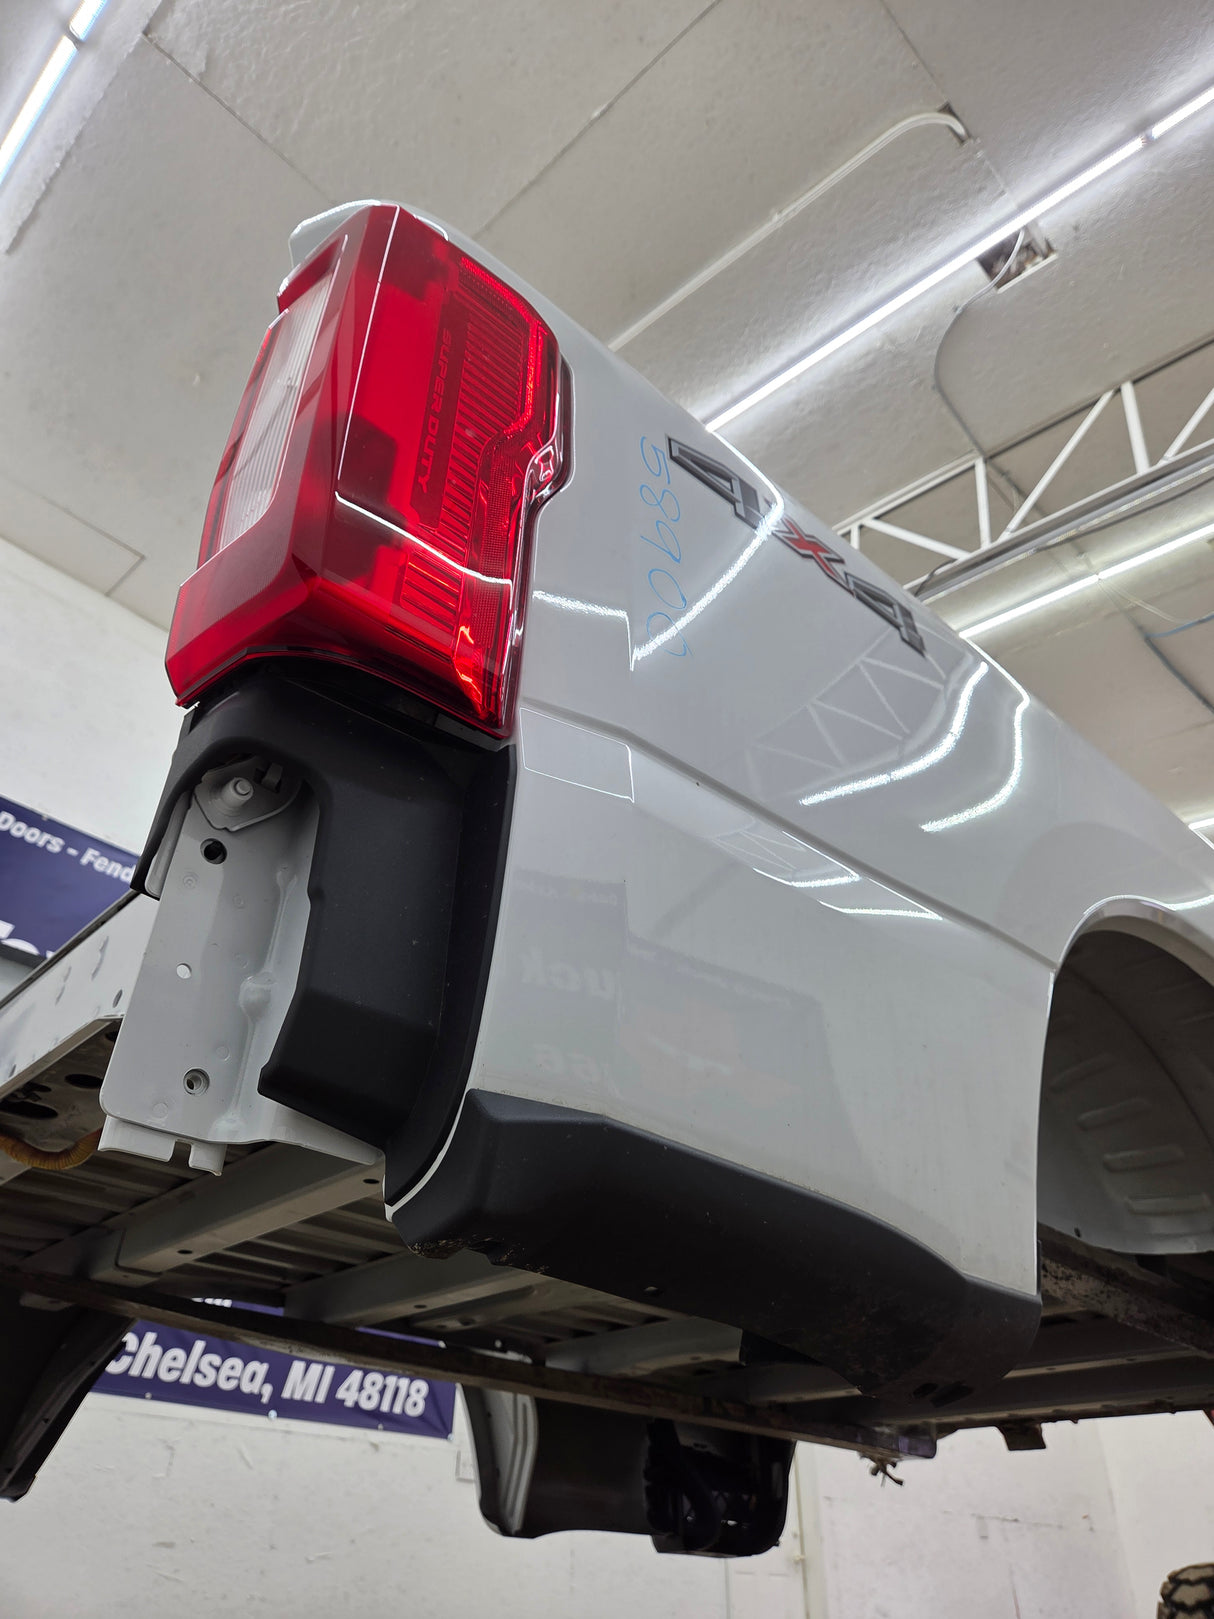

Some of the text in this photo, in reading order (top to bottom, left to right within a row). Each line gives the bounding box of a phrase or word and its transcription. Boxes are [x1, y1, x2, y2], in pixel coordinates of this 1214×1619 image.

[418, 328, 451, 494] SUPER DUTY
[0, 811, 65, 853] Doors
[105, 1331, 429, 1417] Chelsea, MI 48118
